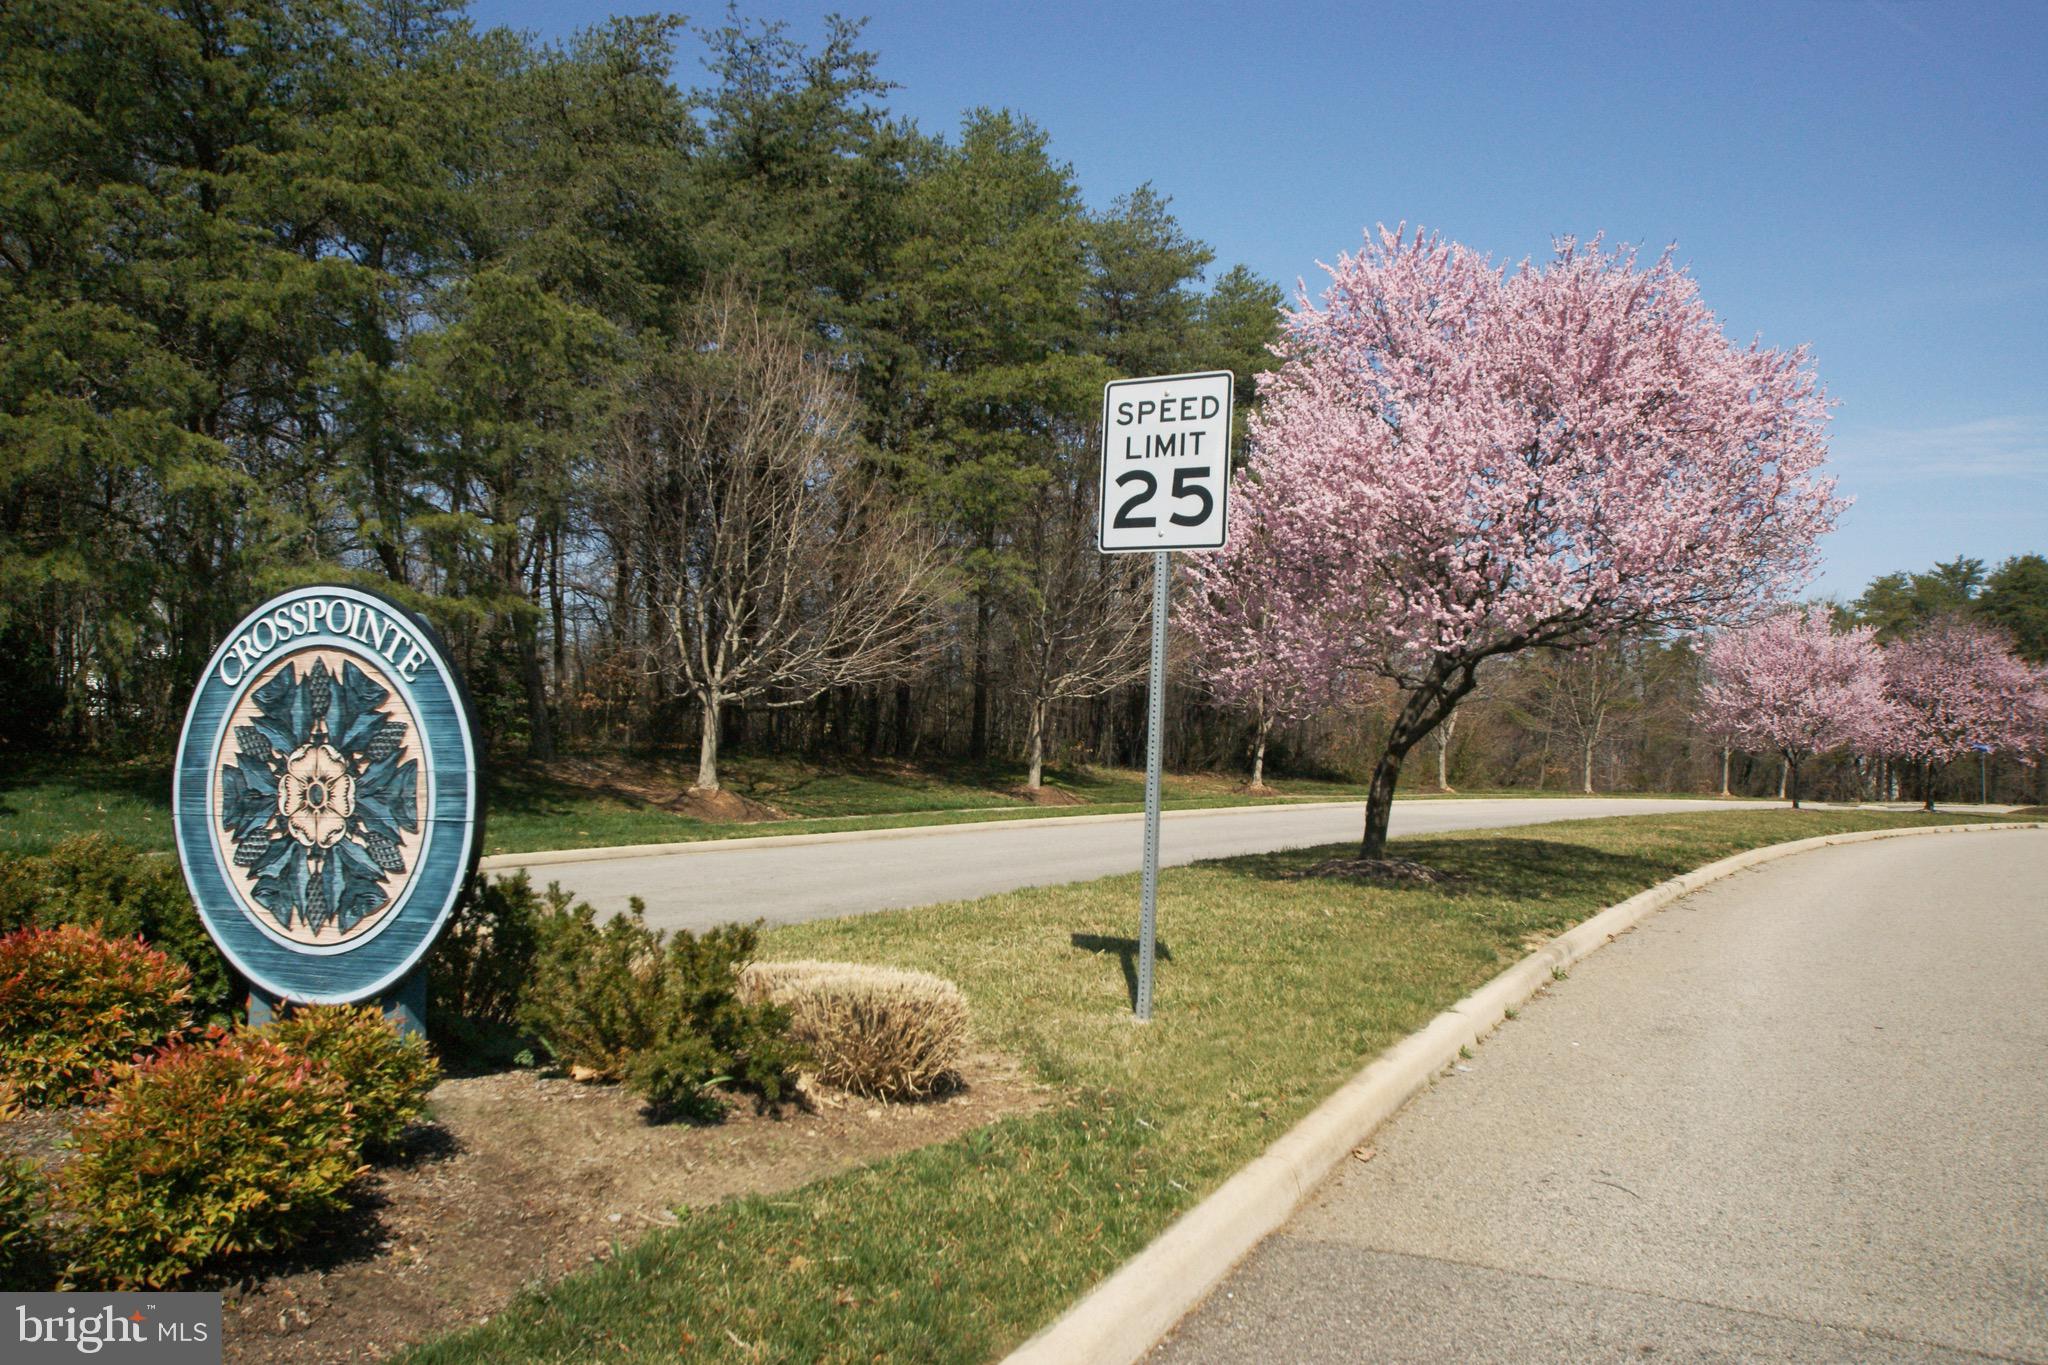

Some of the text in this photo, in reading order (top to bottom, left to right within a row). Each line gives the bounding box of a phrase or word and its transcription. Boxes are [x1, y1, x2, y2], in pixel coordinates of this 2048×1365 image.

[1116, 395, 1219, 426] SPEED
[1125, 431, 1206, 460] LIMIT
[1112, 466, 1214, 529] 25
[219, 599, 427, 686] CROSSPOINTE
